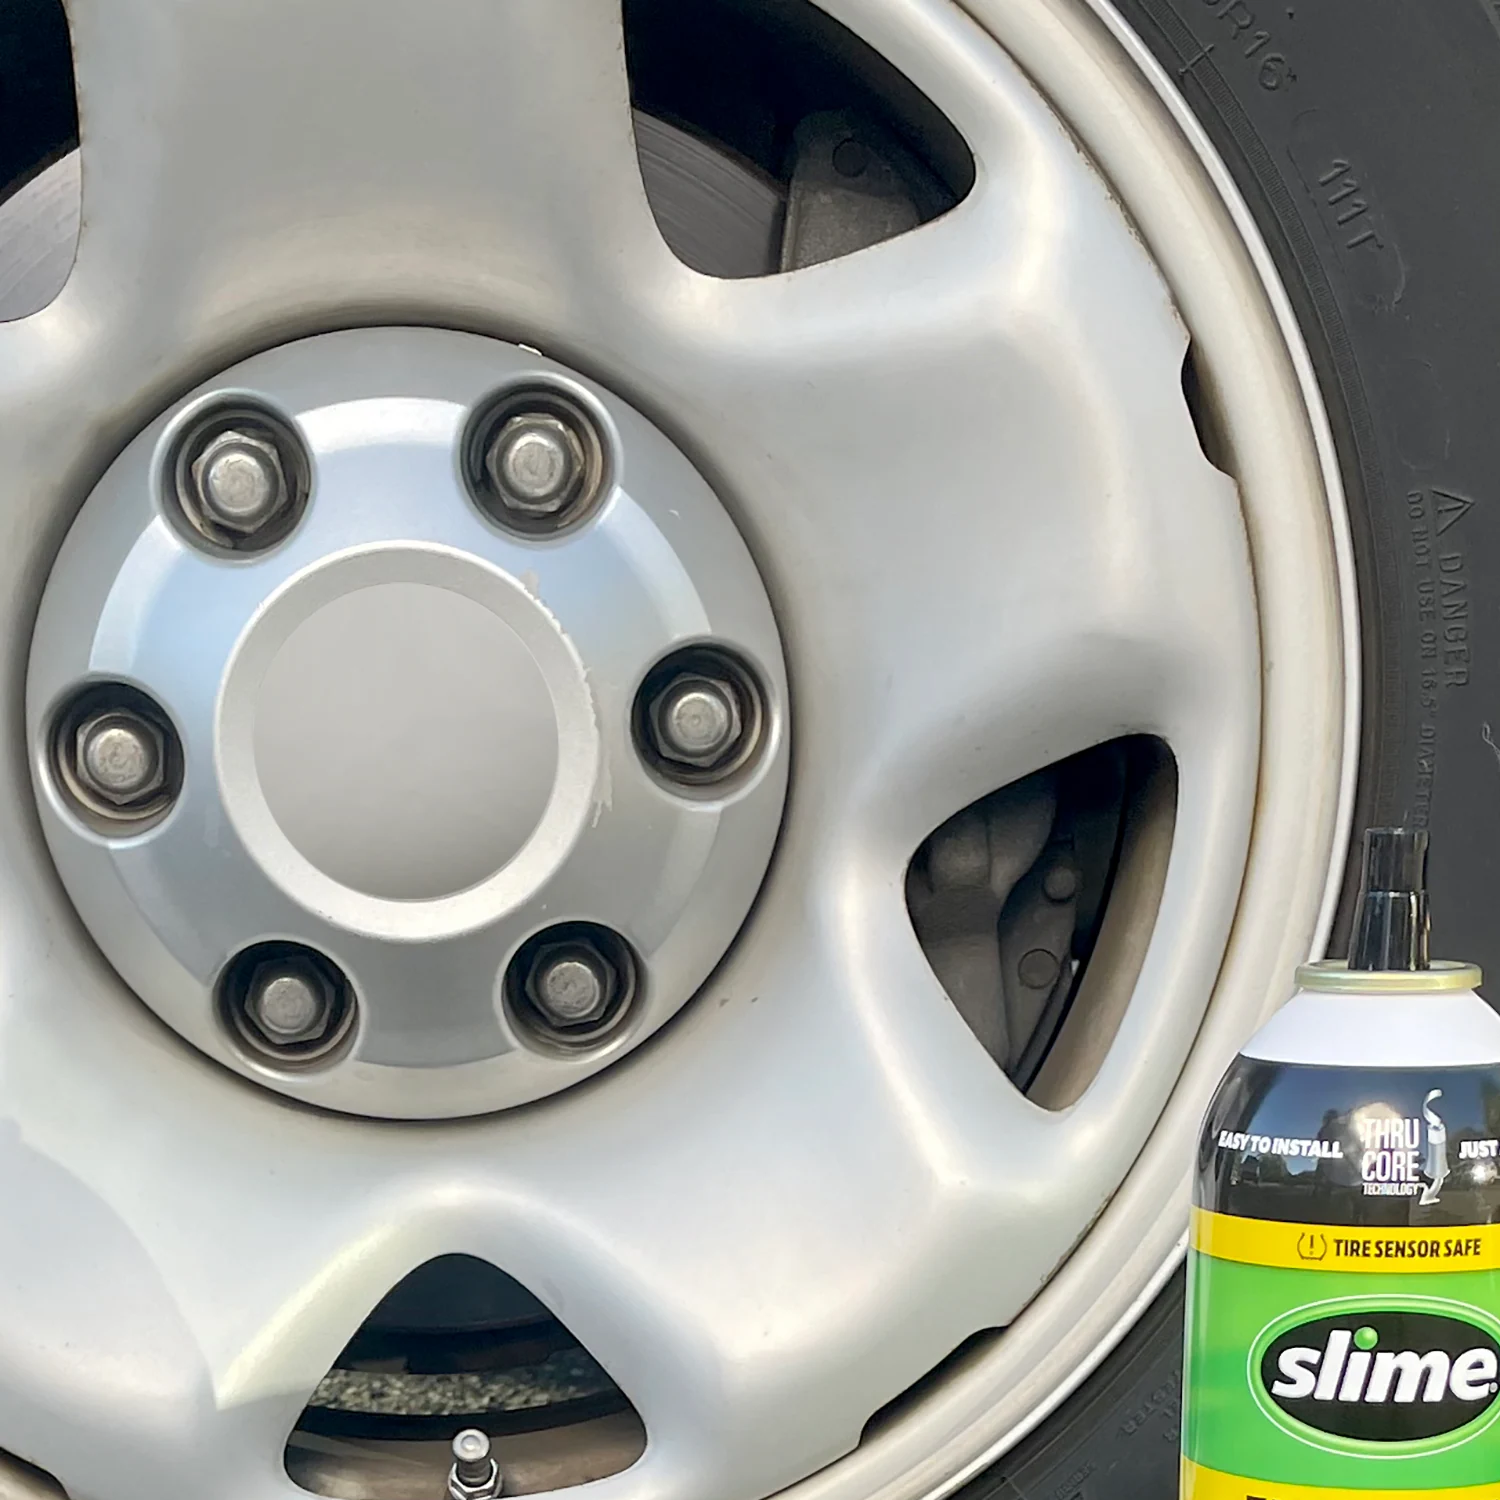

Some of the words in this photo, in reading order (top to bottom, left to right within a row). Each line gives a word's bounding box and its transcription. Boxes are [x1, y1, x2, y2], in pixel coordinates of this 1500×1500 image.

[1203, 0, 1287, 92] R16
[1415, 580, 1436, 622] USE
[1438, 552, 1470, 689] DANGER
[1420, 630, 1437, 659] ON
[1218, 1130, 1248, 1151] EASY
[1249, 1136, 1271, 1153] TO
[1271, 1137, 1343, 1158] INSTALL
[1363, 1118, 1420, 1149] THRU
[1459, 1140, 1498, 1159] JUST
[1361, 1151, 1420, 1182] CORE
[1334, 1238, 1371, 1258] TIRE
[1374, 1239, 1440, 1258] SENSOR
[1443, 1238, 1482, 1258] SAFE
[1270, 1326, 1498, 1403] slime
